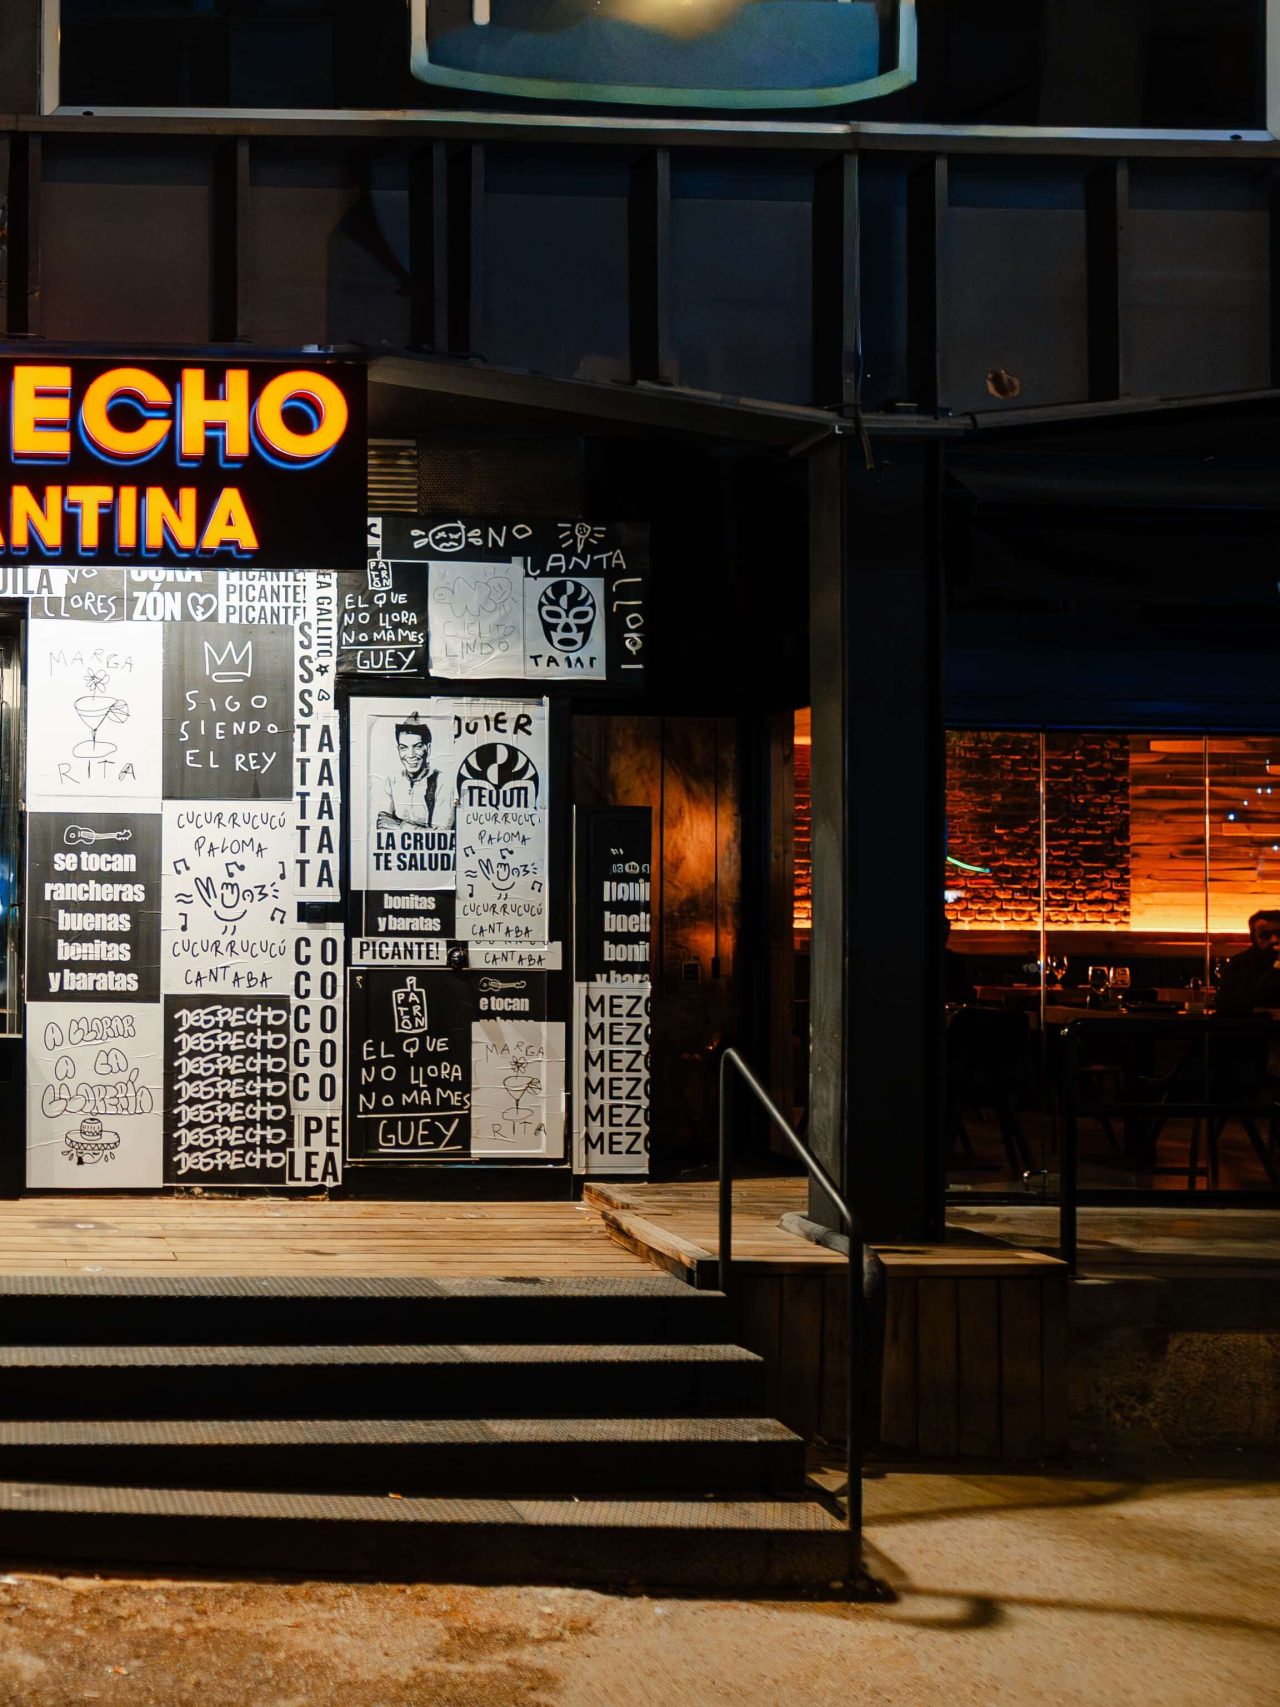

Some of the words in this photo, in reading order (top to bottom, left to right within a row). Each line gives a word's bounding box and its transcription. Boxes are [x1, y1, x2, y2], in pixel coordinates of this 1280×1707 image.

[488, 524, 533, 548] NO
[132, 583, 182, 622] ZÓN
[226, 584, 306, 603] PICANTE!
[345, 593, 369, 610] EL
[373, 592, 408, 608] QUE
[43, 591, 117, 621] LLORES
[316, 595, 332, 658] GALLITO
[343, 611, 370, 627] NO
[379, 610, 418, 630] LLORA
[341, 630, 369, 646] NO
[373, 628, 425, 645] MAMES
[48, 647, 134, 677] MARGA
[356, 649, 417, 671] GUEY
[186, 690, 268, 712] SIGO
[179, 720, 279, 742] SIENDO
[57, 759, 137, 785] RITA
[186, 749, 219, 769] EL
[235, 751, 277, 774] REY
[194, 835, 269, 859] PALOMA
[376, 832, 397, 851] LA
[401, 831, 456, 851] CRUDA
[478, 829, 532, 846] PALOMA
[53, 855, 79, 873] se
[80, 851, 137, 872] tocan
[373, 852, 394, 871] TE
[396, 852, 456, 872] SALUD
[44, 879, 146, 901] rancheras
[383, 893, 436, 910] bonitas
[57, 909, 131, 932] buenas
[377, 917, 387, 932] y
[387, 915, 442, 933] baratas
[471, 921, 534, 938] CANTABA
[56, 939, 131, 962] bonitas
[359, 940, 440, 961] PICANTE!
[484, 950, 547, 967] CANTABA
[48, 972, 62, 993] y
[63, 968, 139, 992] baratas
[184, 965, 273, 989] CANTABA
[490, 996, 530, 1012] tocan
[173, 1004, 287, 1032] DESPECHO
[173, 1028, 287, 1056] DESPECHO
[362, 1038, 396, 1062] EL
[402, 1037, 450, 1059] QUE
[173, 1053, 287, 1080] DESPECHO
[360, 1066, 397, 1086] NO
[410, 1062, 463, 1090] LLORA
[173, 1076, 287, 1104] DESPECHO
[359, 1093, 394, 1113] NO
[401, 1087, 471, 1111] MAMES
[173, 1101, 287, 1128] DESPECHO
[173, 1124, 287, 1152] DESPECHO
[377, 1118, 461, 1149] GUEY
[173, 1149, 287, 1175] DESPECHO
